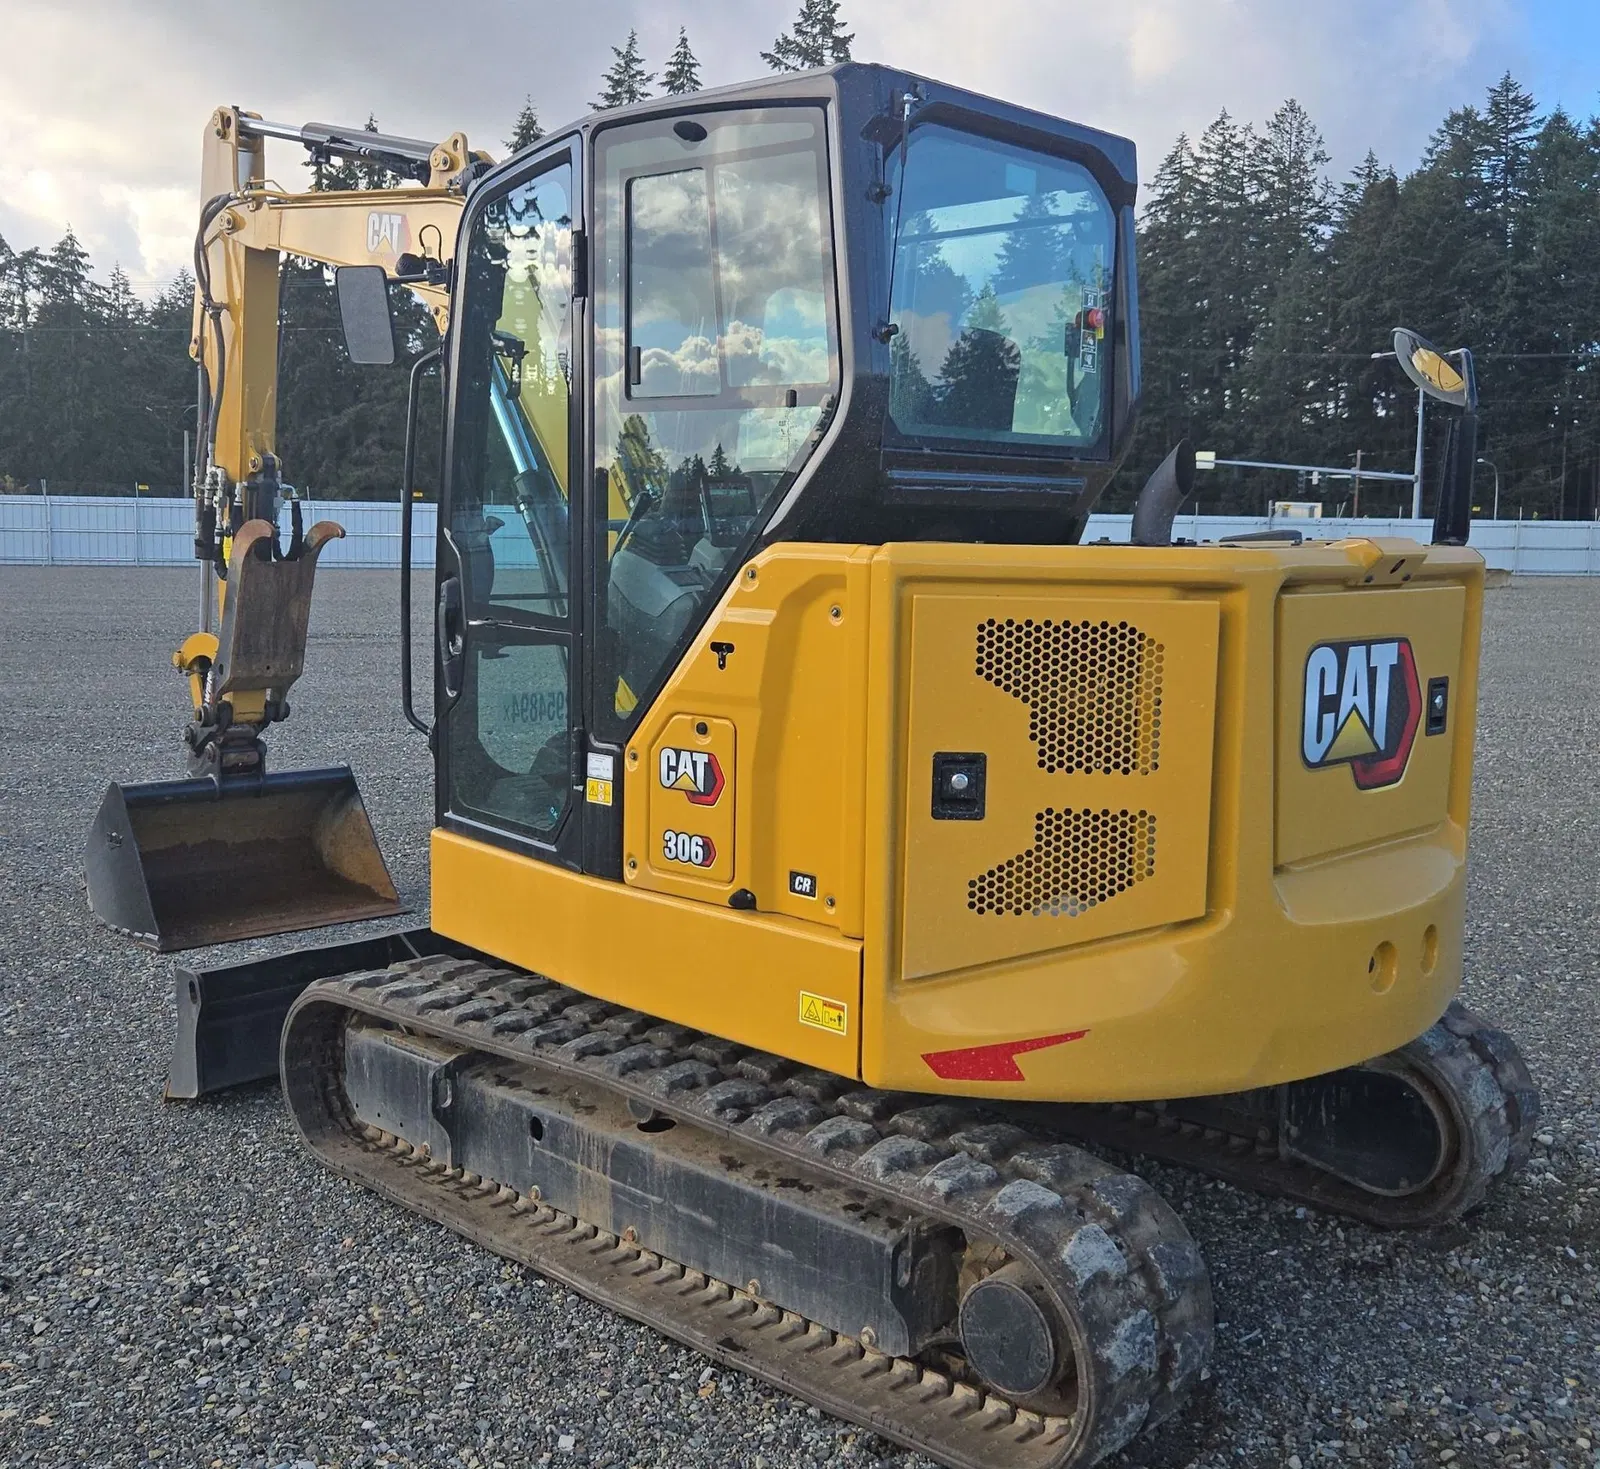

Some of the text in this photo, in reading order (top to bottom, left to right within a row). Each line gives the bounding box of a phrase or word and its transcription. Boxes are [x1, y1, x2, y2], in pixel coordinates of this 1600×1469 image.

[367, 212, 402, 254] CAT
[1303, 642, 1399, 763] CAT
[660, 747, 709, 793] CAT
[663, 830, 704, 865] 306
[795, 876, 812, 893] CR
